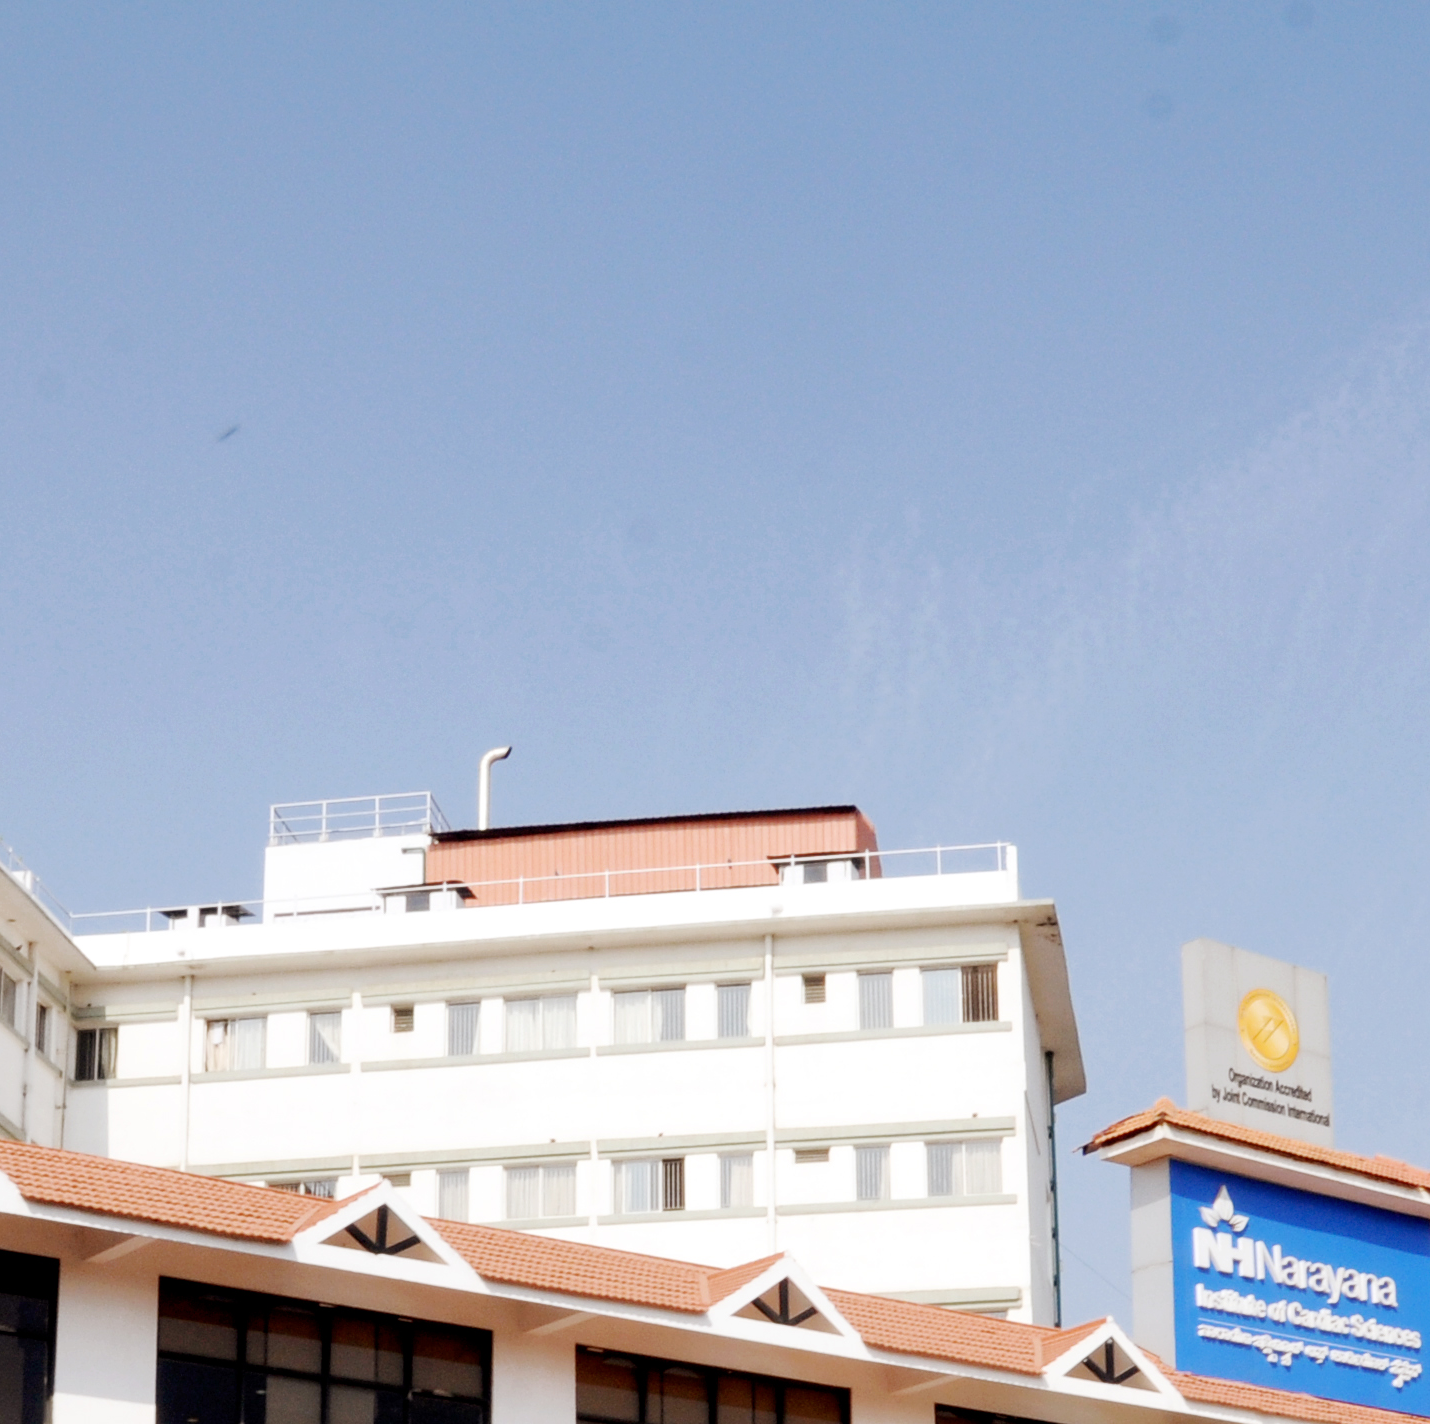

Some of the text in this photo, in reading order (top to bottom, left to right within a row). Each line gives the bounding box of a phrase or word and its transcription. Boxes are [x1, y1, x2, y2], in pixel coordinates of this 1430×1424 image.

[1211, 1083, 1221, 1103] by
[1255, 1241, 1398, 1307] Narayana
[1195, 1282, 1422, 1349] Institute of Cardiac Sciences
